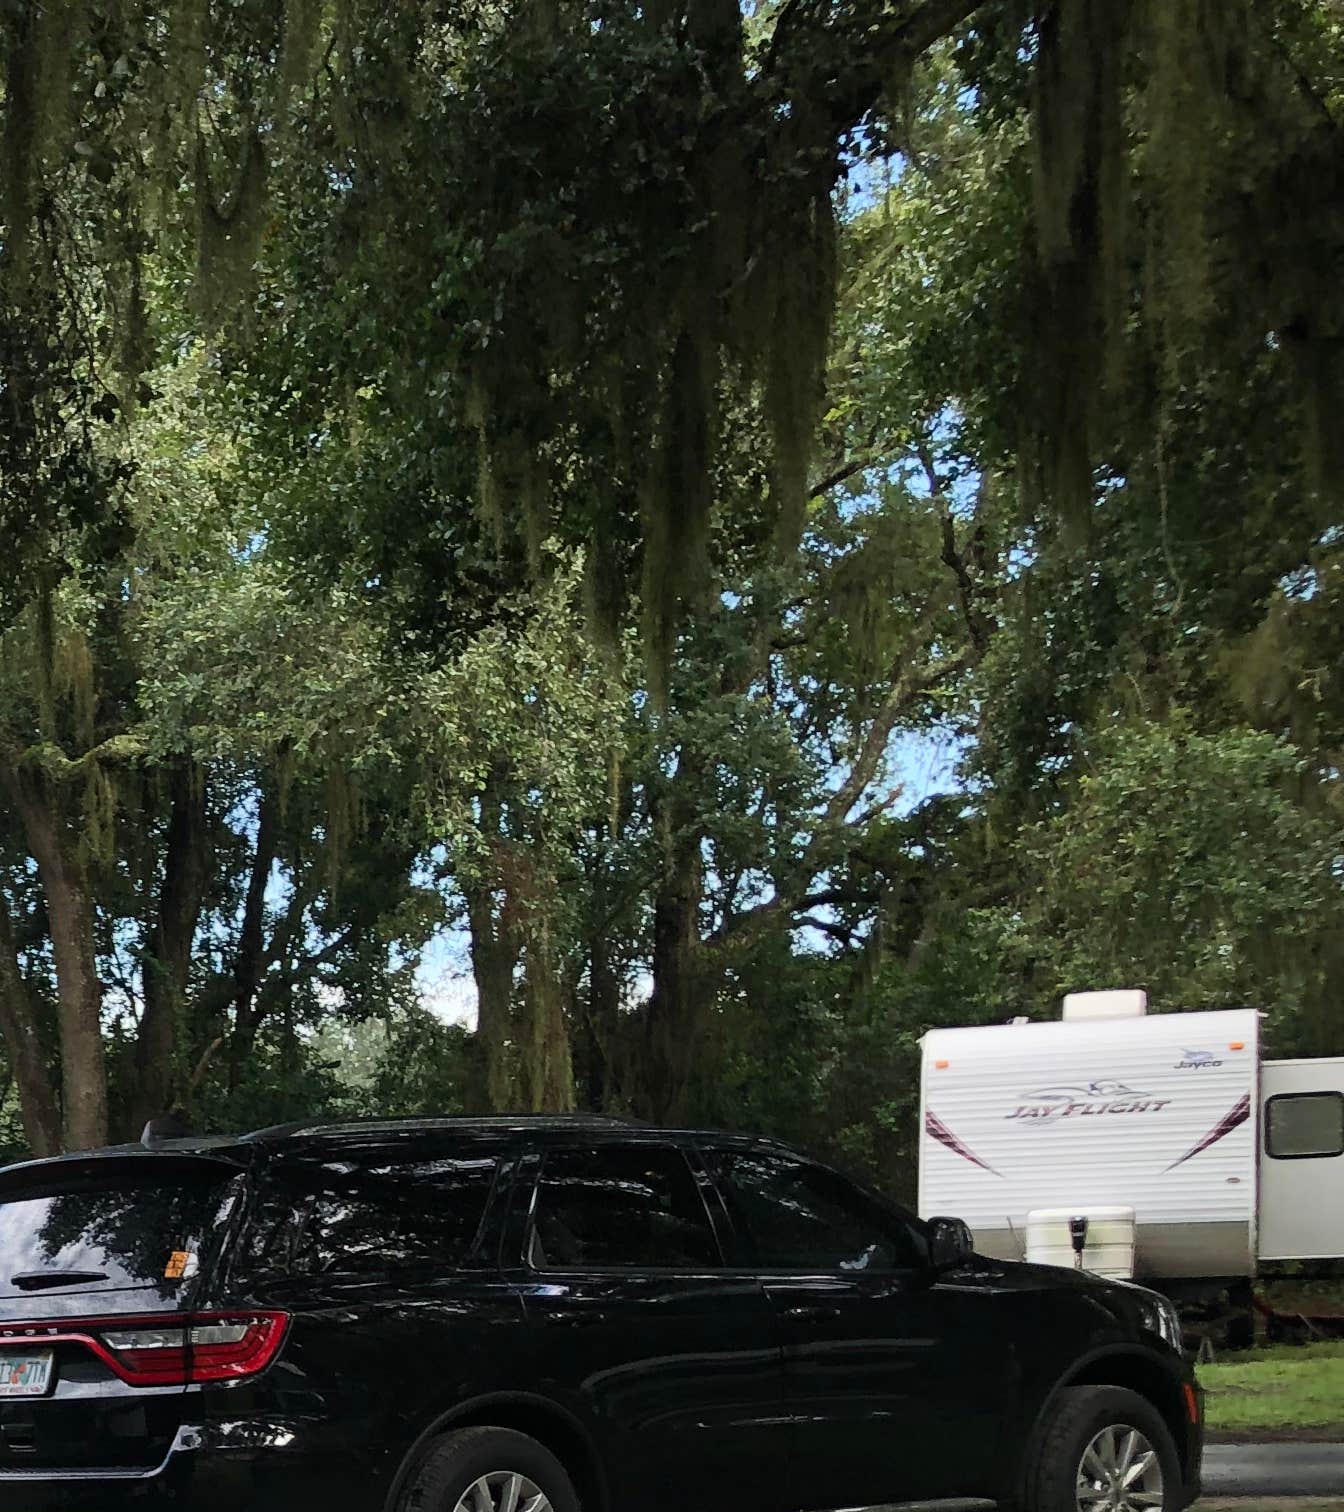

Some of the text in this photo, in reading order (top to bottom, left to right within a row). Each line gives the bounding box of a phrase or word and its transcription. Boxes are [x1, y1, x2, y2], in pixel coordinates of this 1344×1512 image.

[1174, 1060, 1224, 1069] Jayco
[1004, 1100, 1171, 1119] JAY FLIGHT
